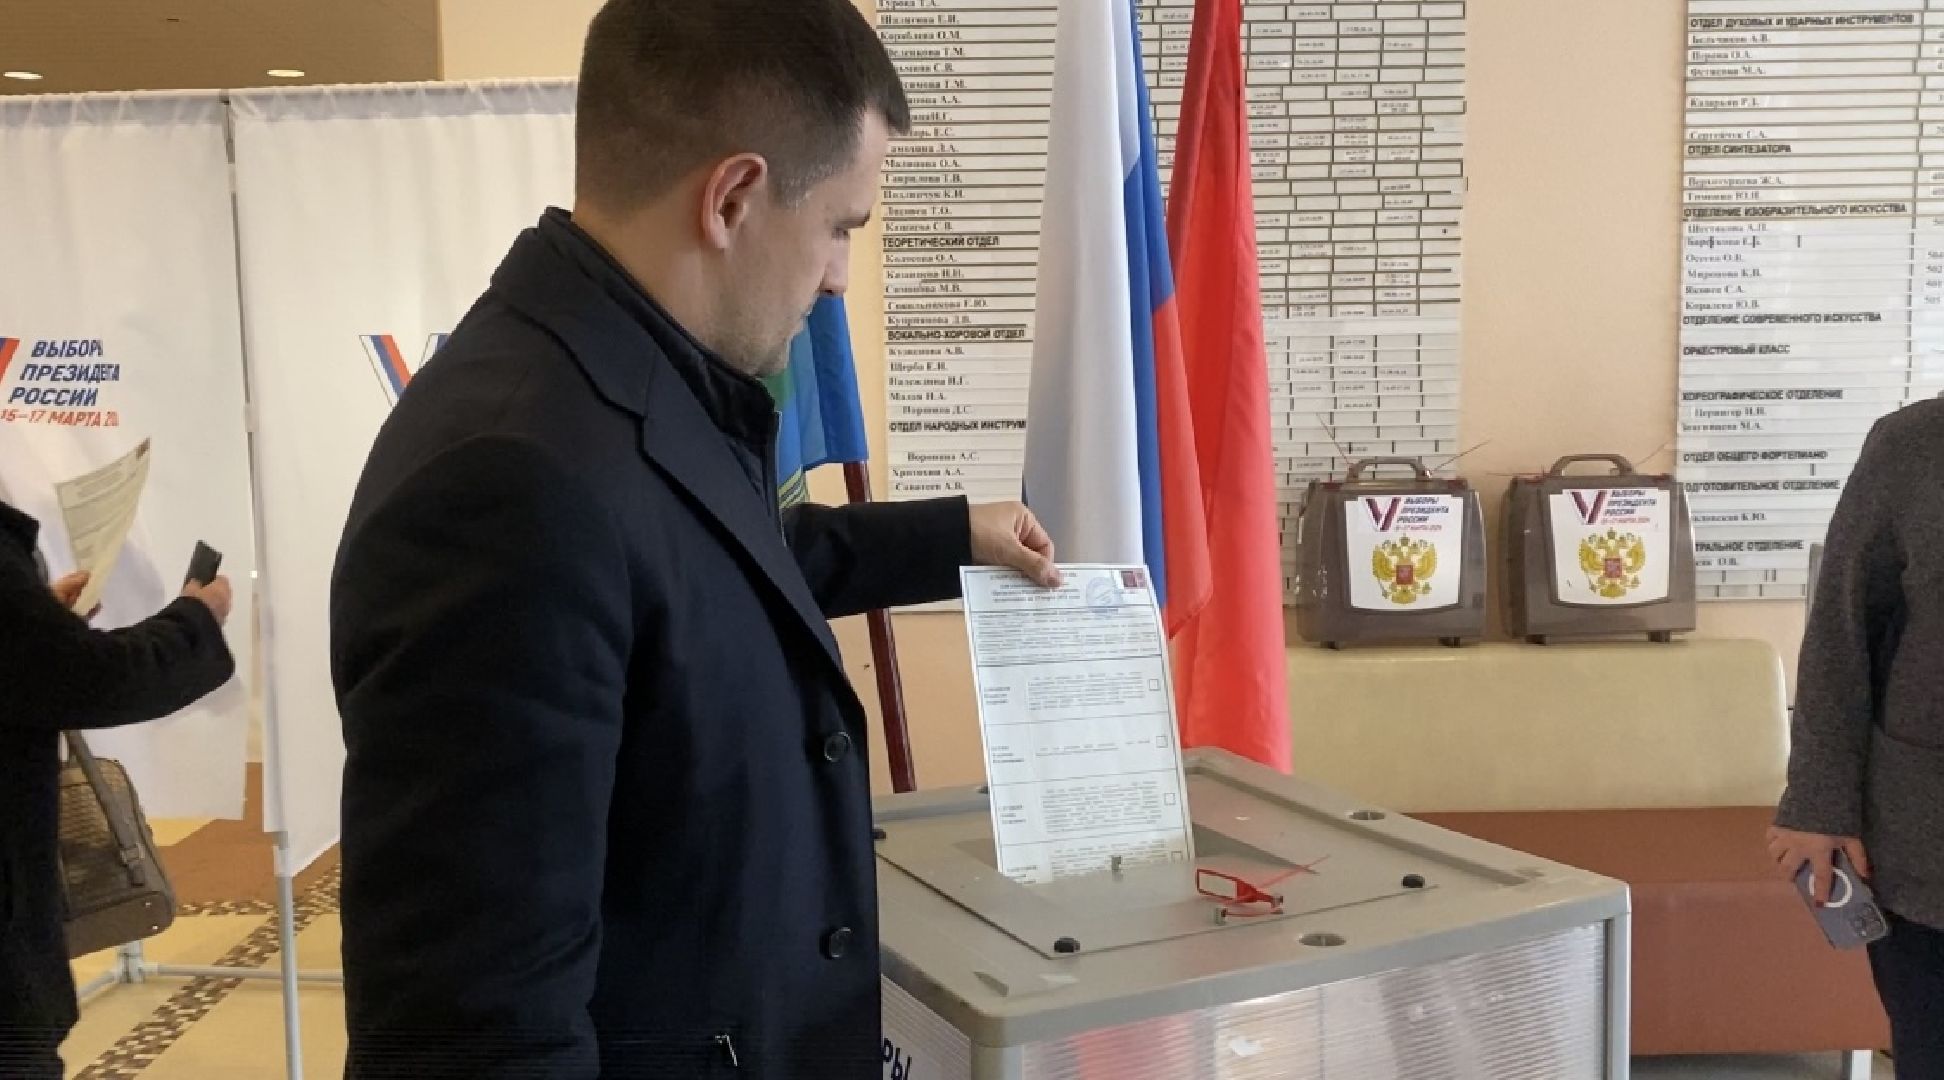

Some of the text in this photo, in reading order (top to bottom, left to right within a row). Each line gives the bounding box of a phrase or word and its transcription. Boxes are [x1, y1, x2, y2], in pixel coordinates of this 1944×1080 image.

[1691, 18, 1722, 28] ОТДЕЛ
[1835, 15, 1914, 24] ИНСТРУМЕНТОВ
[1688, 144, 1791, 155] ОТДЕЛ СИНТЕЗАТОРА
[1684, 203, 1907, 217] ОТДЕЛЕНИЕ ИЗОБРАЗИТЕЛЬНОГО ИСКУССТВА
[882, 236, 999, 248] ТЕОРЕТИЧЕСКИЙ ОТДЕЛ
[1683, 312, 1881, 325] ОТДЕЛЕНИЕ СОВРЕМЕННОГО ИСКУССТВА
[993, 330, 1025, 338] ОТДЕЛ
[1683, 344, 1790, 355] ОРКЕСТРОВЫЙ КЛАСС
[8, 387, 98, 406] РОССИИ
[1683, 389, 1843, 400] ХОРЕОГРАФИЧЕСКОЕ ОТДЕЛЕНИЕ
[48, 411, 100, 426] МАРТА
[889, 421, 1026, 432] ОТДЕЛ НАРОДНЫХ ИНСТРУМ
[1683, 451, 1828, 462] ОТДЕЛ ОБЩЕГО ФОРТЕПИАНО
[1684, 480, 1840, 492] ОДГОТОВИТЕЛЬНОЕ ОТДЕЛЕНИЕ
[1695, 540, 1804, 552] ТРАЛЬНОЕ ОТДЕЛЕНИЕ
